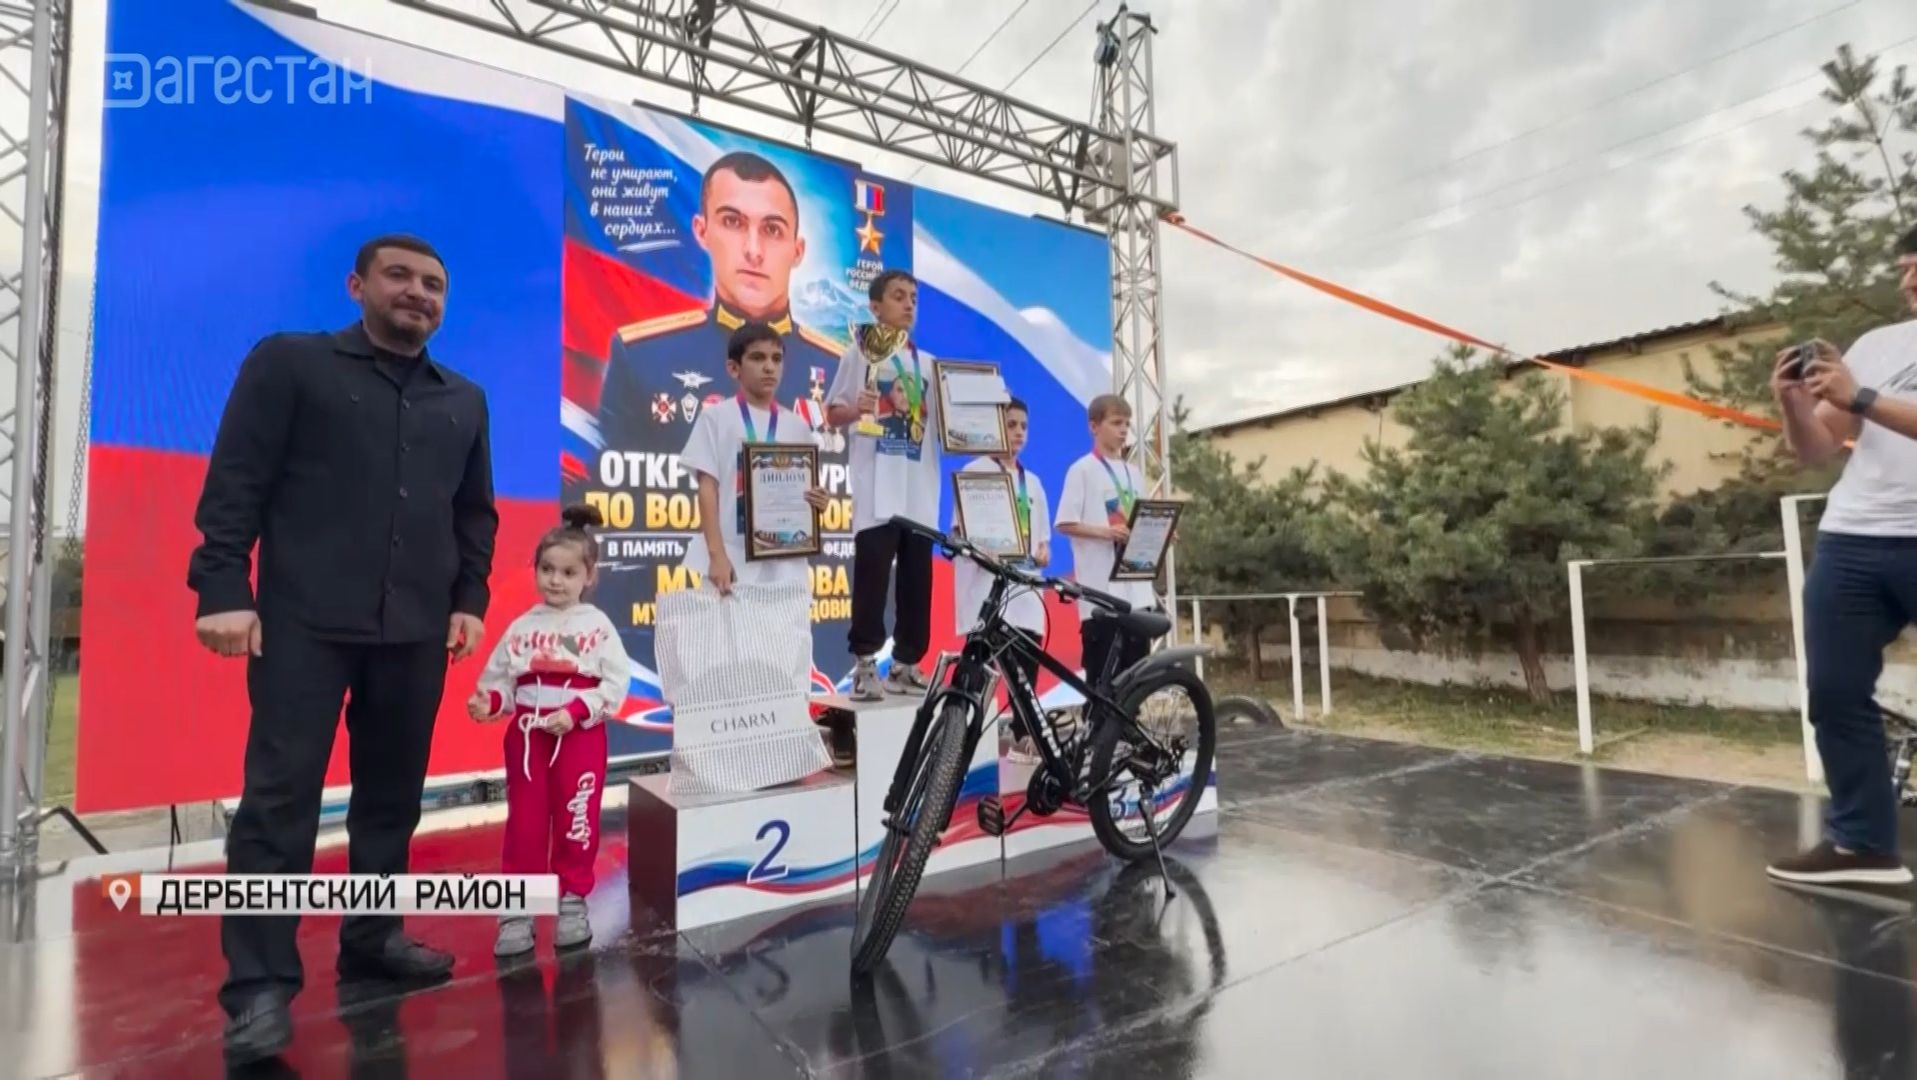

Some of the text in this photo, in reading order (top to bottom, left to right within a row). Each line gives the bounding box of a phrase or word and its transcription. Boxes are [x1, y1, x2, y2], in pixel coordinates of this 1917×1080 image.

[591, 167, 678, 186] не умирают,
[591, 181, 669, 204] они живут
[590, 201, 654, 218] в наших
[604, 217, 676, 241] сердцах...
[607, 541, 618, 557] В
[622, 541, 684, 557] ПАМЯТЬ
[710, 711, 776, 734] CHARM
[747, 819, 790, 883] 2
